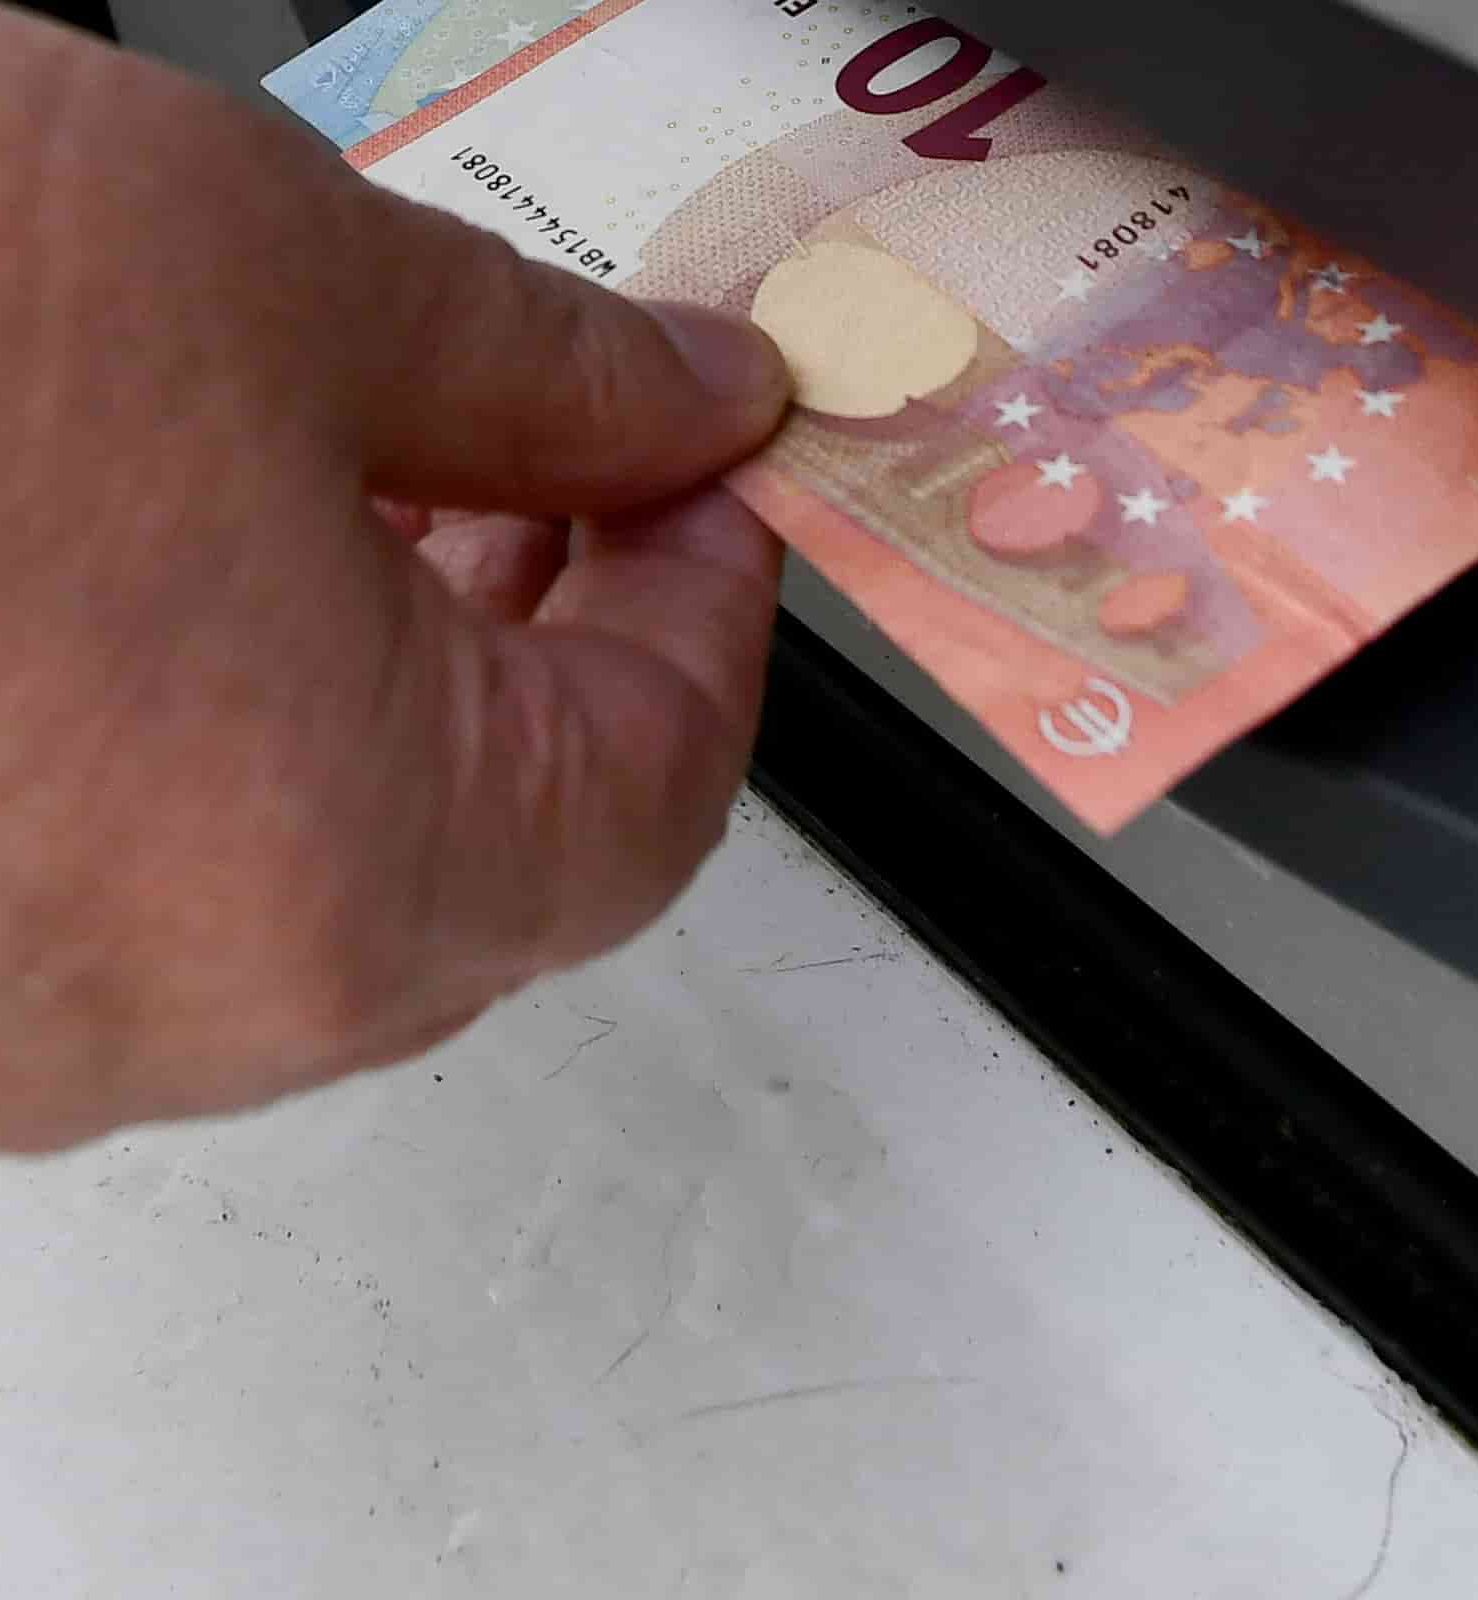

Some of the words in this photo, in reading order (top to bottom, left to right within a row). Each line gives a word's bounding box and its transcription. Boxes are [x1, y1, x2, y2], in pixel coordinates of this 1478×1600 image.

[835, 16, 1048, 162] 10
[450, 145, 617, 278] WB1544418081
[1075, 185, 1191, 272] 418081
